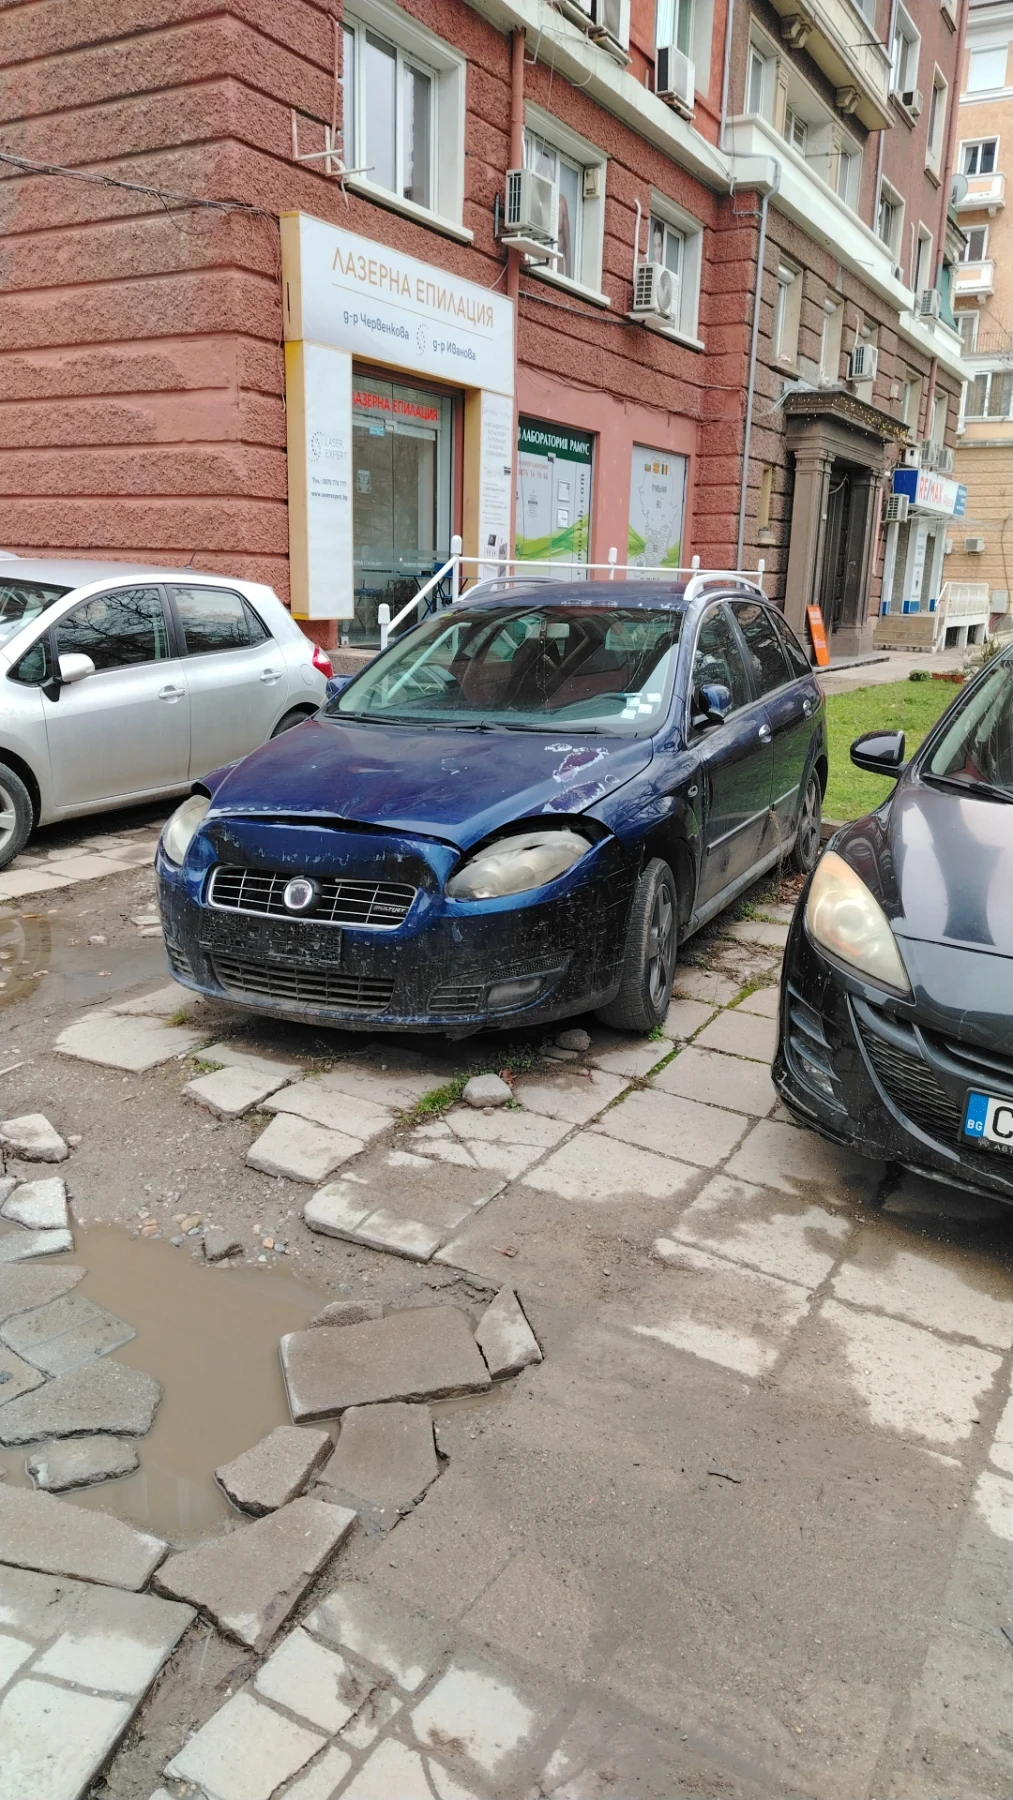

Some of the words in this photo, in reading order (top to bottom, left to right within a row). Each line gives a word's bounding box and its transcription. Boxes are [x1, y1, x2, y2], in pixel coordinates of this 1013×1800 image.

[332, 247, 412, 299] ЛАЗЕРНА
[416, 278, 494, 328] ЕПИЛАЦИЯ
[360, 312, 410, 340] Червенкова
[446, 341, 476, 361] Иванова
[392, 399, 438, 421] ЕПИЛАЦИЯ
[324, 437, 344, 449] LASER
[522, 428, 568, 450] ЛАБОРАТОРИЯ
[569, 439, 590, 456] РАМУС
[324, 449, 347, 460] EXPERT
[918, 476, 944, 505] RE/MAX
[967, 1118, 983, 1131] BG
